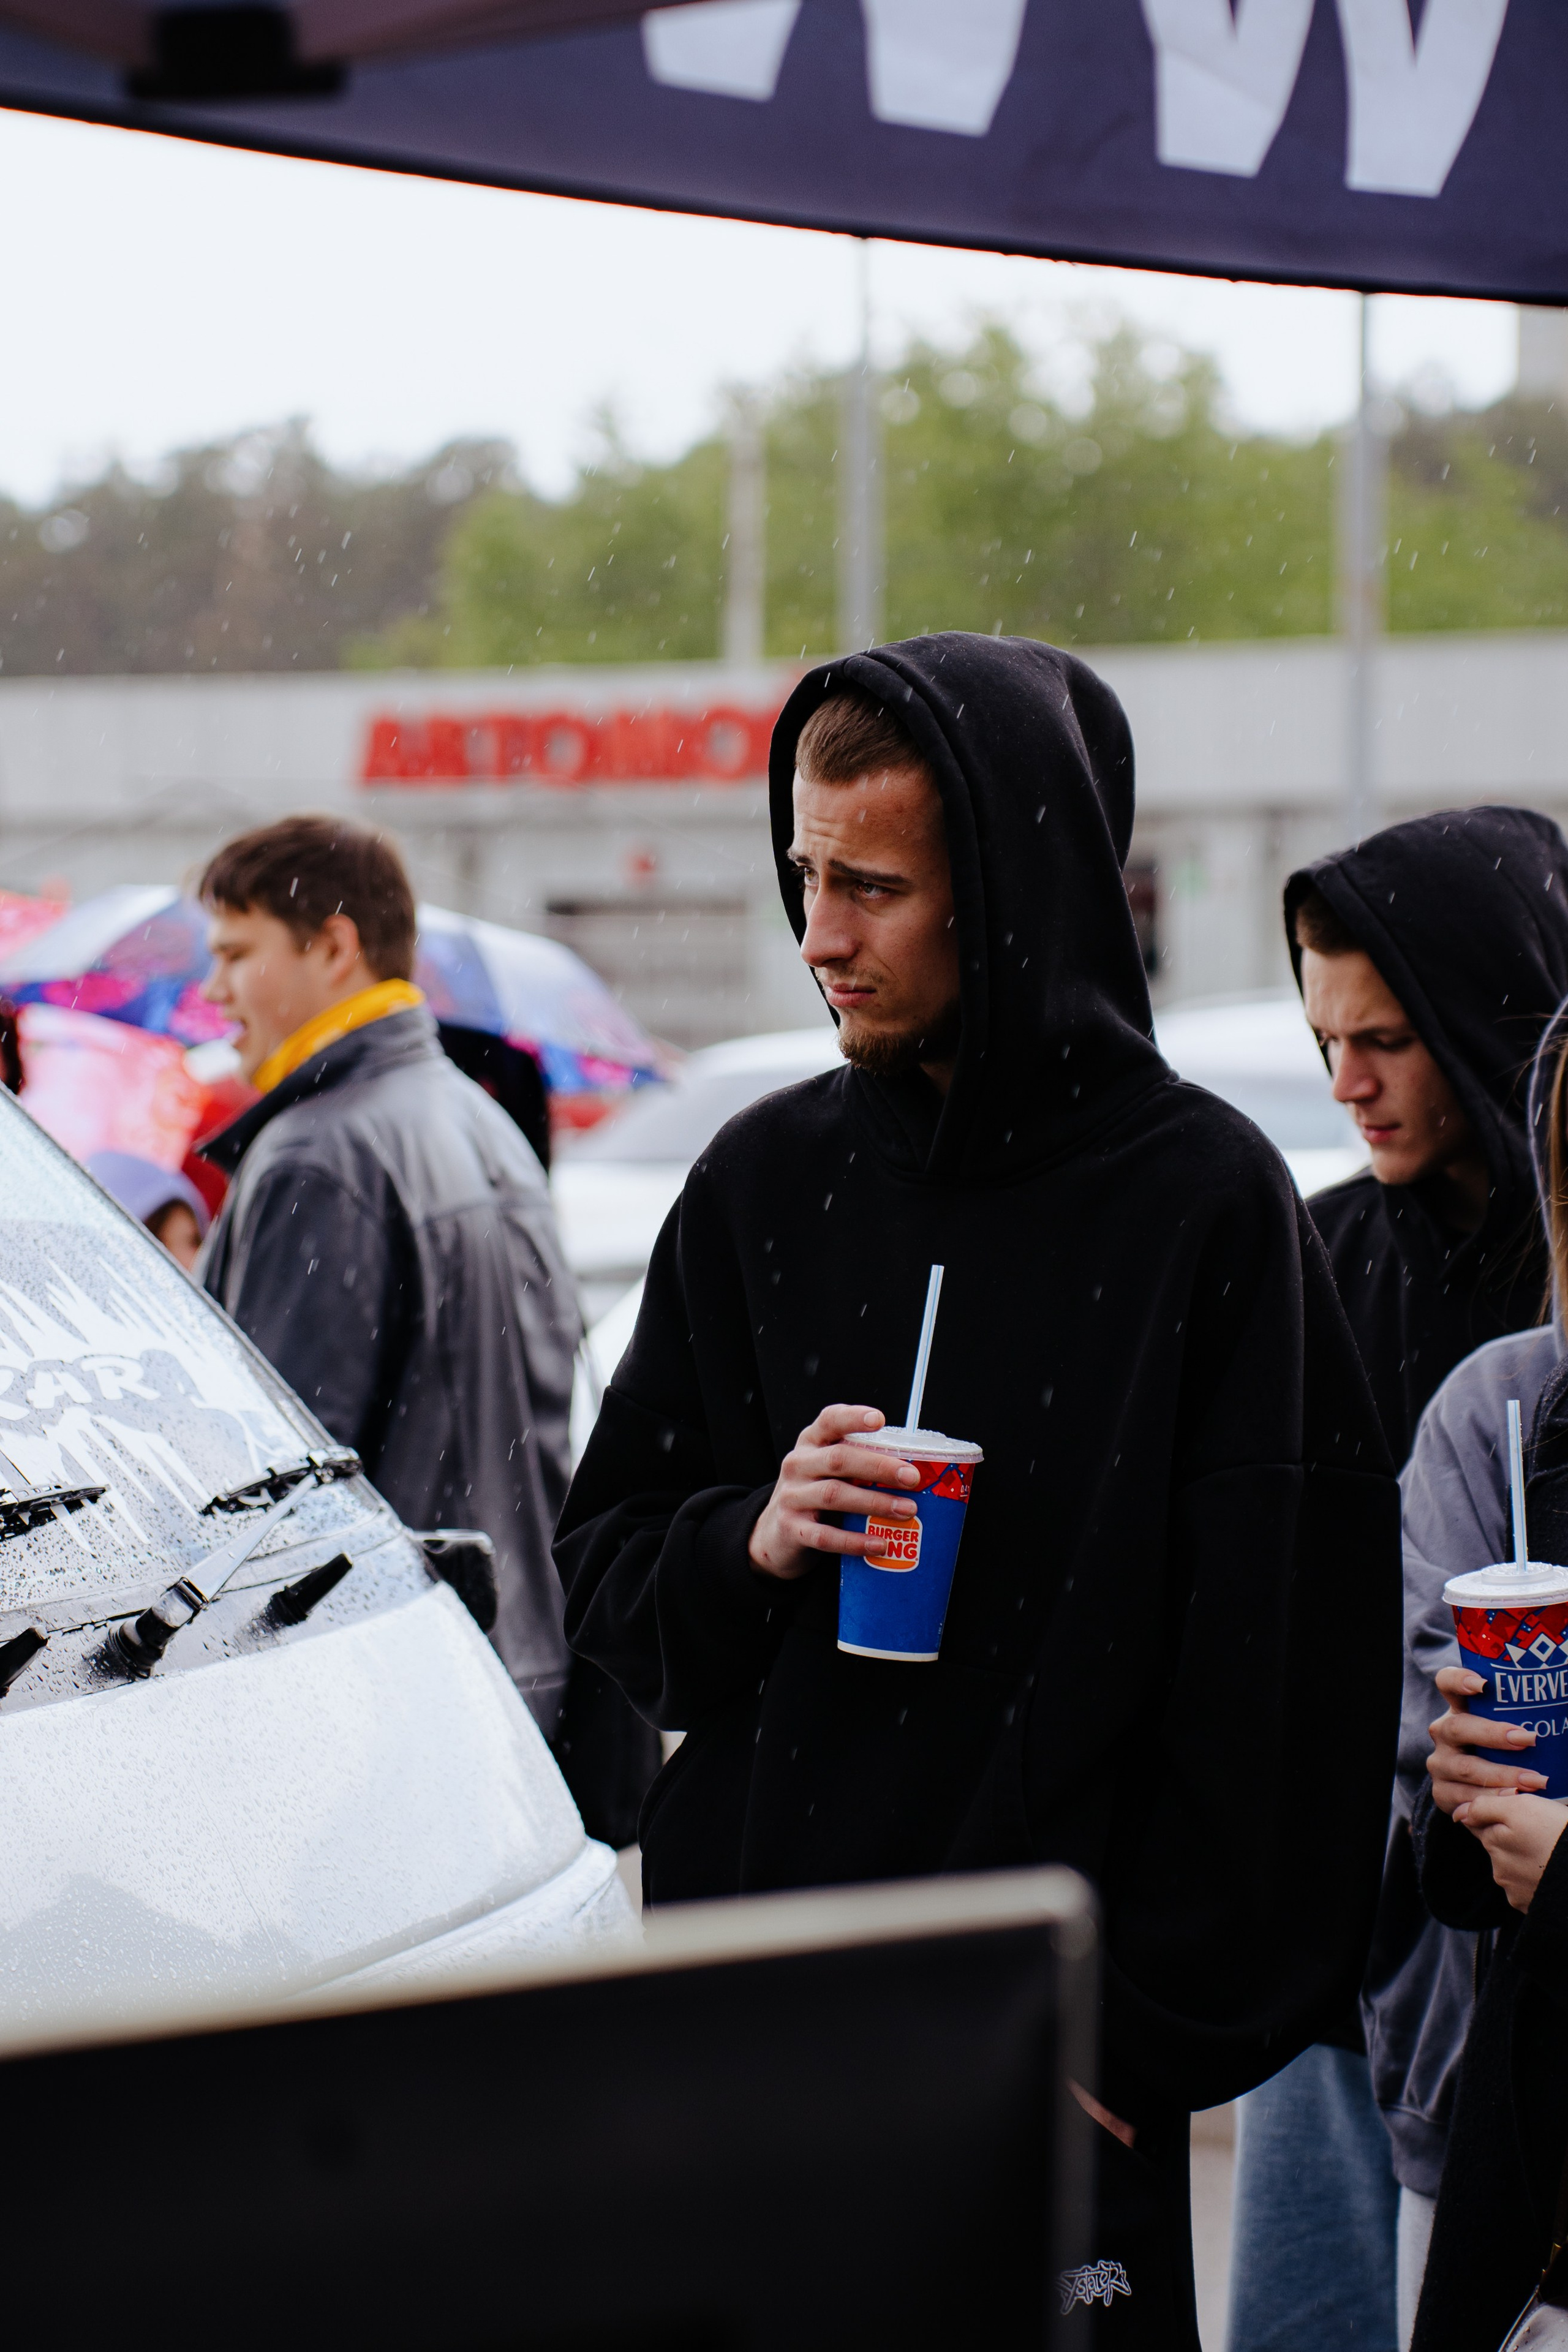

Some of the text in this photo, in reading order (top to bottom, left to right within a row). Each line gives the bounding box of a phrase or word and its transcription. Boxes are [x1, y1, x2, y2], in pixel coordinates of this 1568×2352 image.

[868, 1525, 919, 1542] BURGER
[881, 1541, 918, 1559] NG
[1494, 1669, 1568, 1703] EVERVE
